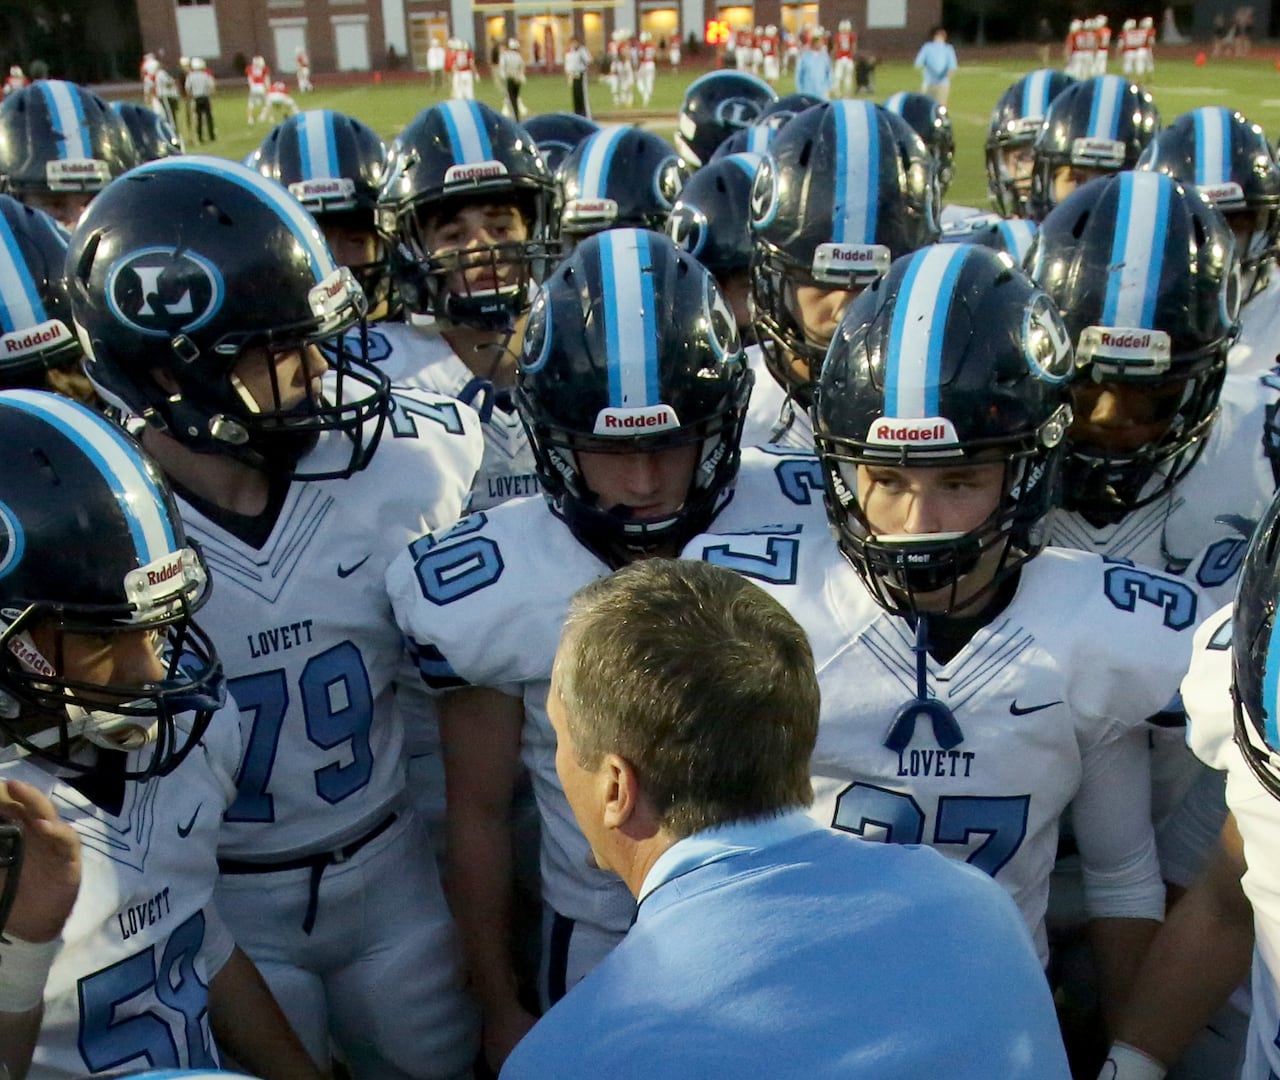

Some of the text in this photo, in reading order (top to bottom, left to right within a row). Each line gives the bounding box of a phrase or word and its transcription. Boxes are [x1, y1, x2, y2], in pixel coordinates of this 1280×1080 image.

[452, 165, 501, 183] Riddell
[832, 248, 873, 262] Riddell
[132, 267, 194, 315] L
[4, 325, 62, 354] Riddell
[1101, 332, 1150, 350] Riddell
[606, 411, 668, 429] Riddell
[877, 425, 945, 441] Riddell
[147, 557, 184, 586] Riddell
[247, 620, 313, 658] LOVETT
[224, 639, 375, 824] 79
[897, 750, 975, 777] LOVETT
[118, 888, 171, 940] LOVETT
